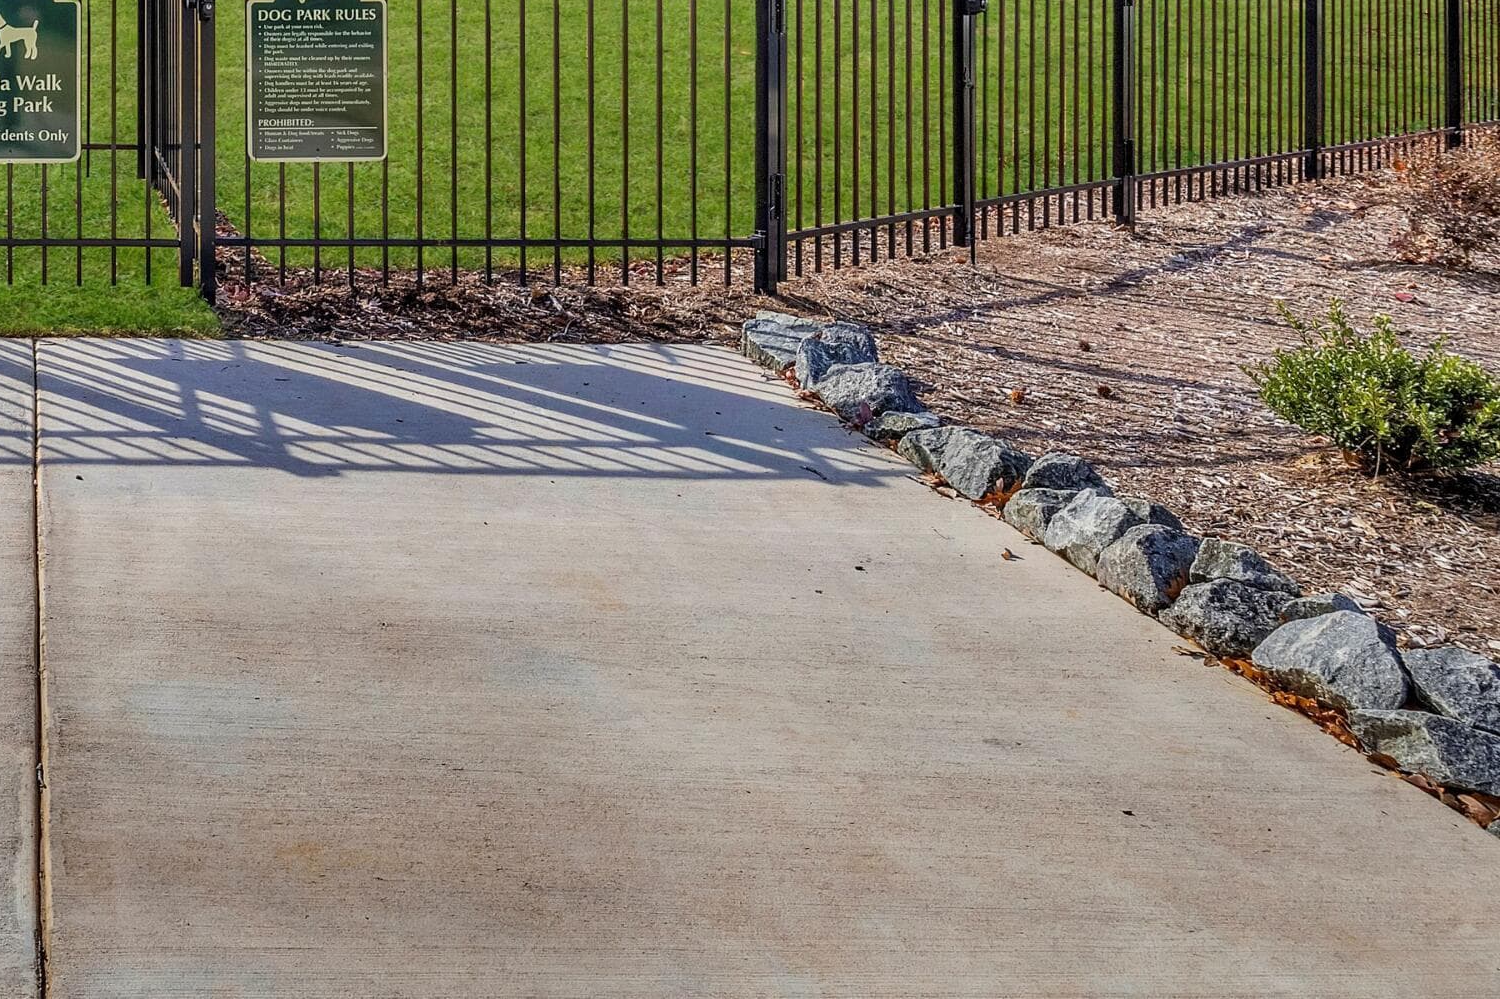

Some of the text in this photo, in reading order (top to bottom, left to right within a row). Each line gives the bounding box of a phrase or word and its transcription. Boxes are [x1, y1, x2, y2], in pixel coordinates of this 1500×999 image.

[258, 8, 376, 21] DOG PARK RULES
[16, 74, 62, 91] Walk
[13, 96, 53, 113] Park
[258, 118, 314, 127] PROHIBITED:
[38, 129, 69, 144] Only
